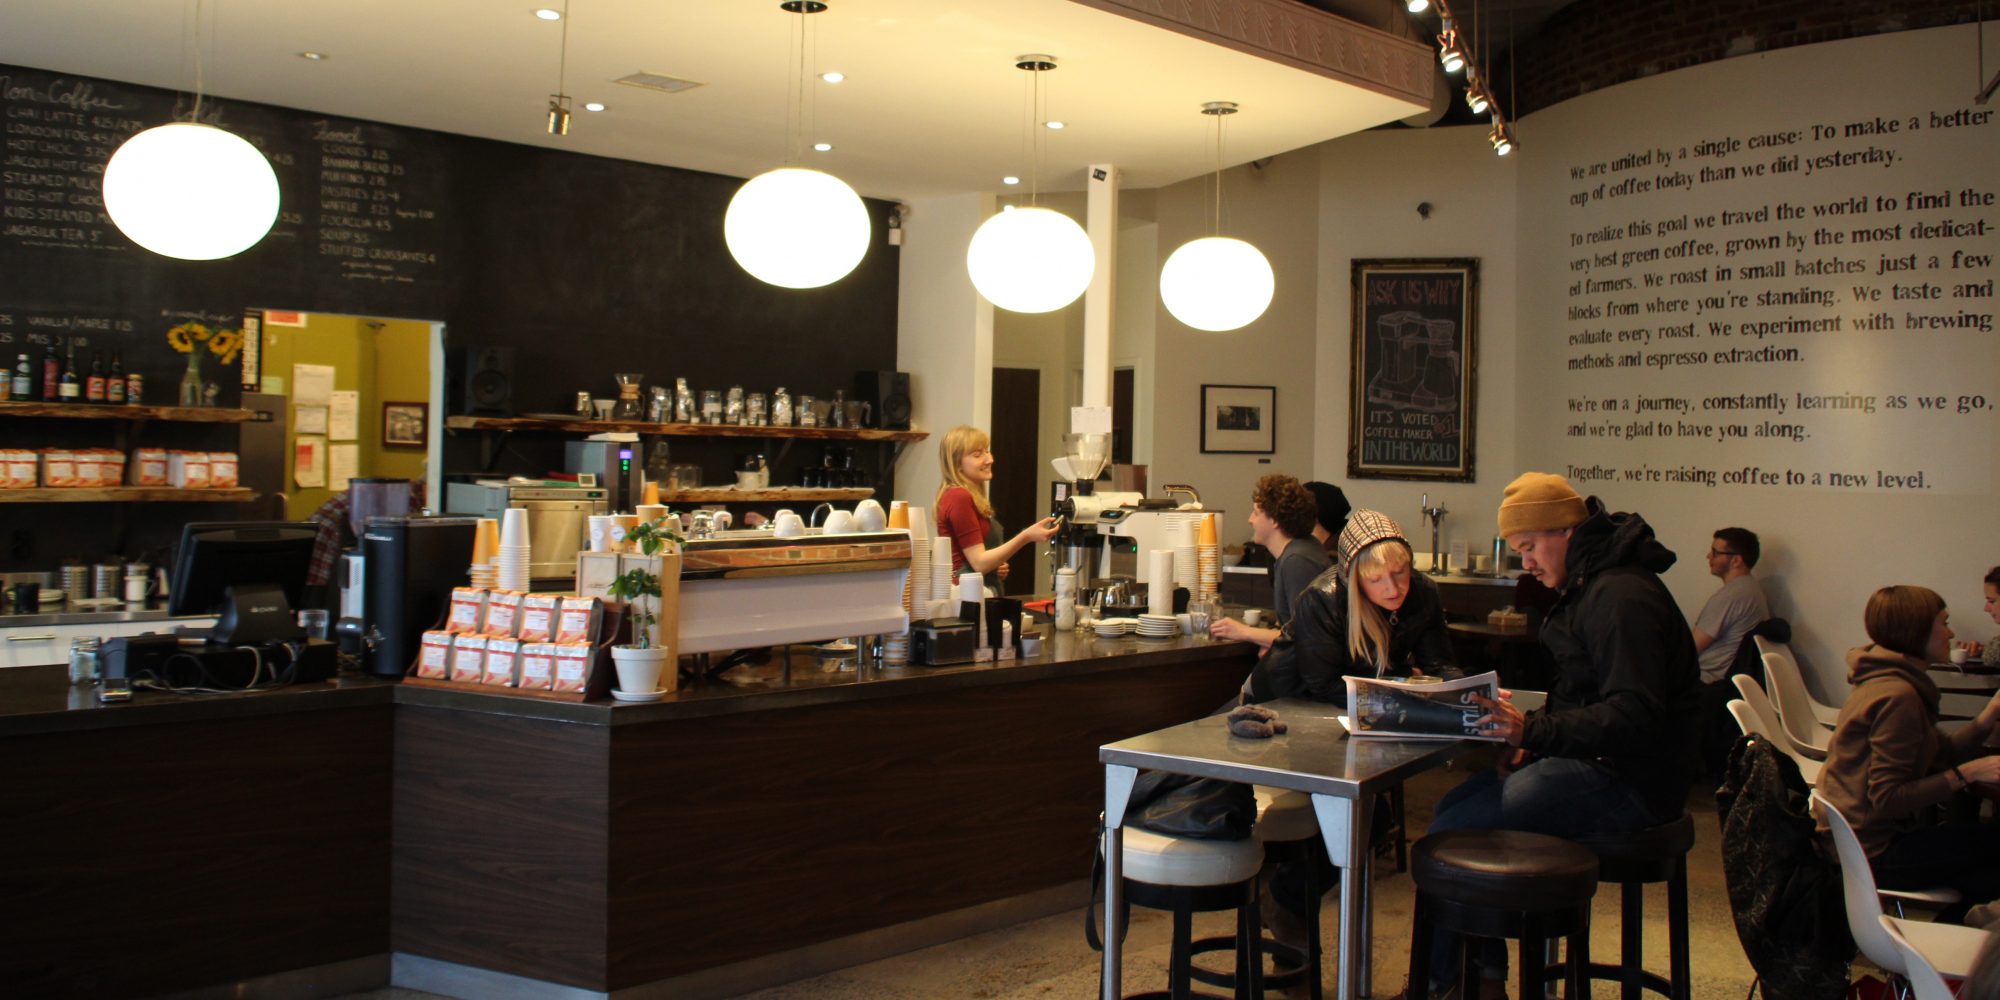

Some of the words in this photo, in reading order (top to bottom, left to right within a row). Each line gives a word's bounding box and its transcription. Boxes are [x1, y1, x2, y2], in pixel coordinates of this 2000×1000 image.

[7, 106, 41, 119] CHAI
[44, 110, 85, 125] LATTE
[6, 122, 62, 138] LONDON
[64, 130, 89, 142] FOG
[6, 139, 37, 151] HOT
[1571, 167, 1585, 180] We
[1589, 163, 1607, 176] are
[1611, 149, 1651, 172] united
[1657, 148, 1672, 168] by
[1679, 147, 1686, 159] a
[1694, 137, 1741, 158] single
[1748, 131, 1802, 150] cause:
[1811, 125, 1836, 141] To
[1844, 117, 1900, 138] make
[1908, 117, 1920, 130] a
[1930, 109, 1994, 128] better
[52, 160, 78, 171] HOT
[1570, 192, 1588, 207] cup
[1592, 184, 1605, 200] of
[1609, 178, 1651, 198] coffee
[1656, 171, 1694, 191] today
[1700, 166, 1735, 183] than
[1741, 164, 1765, 177] we
[1771, 155, 1799, 174] did
[1805, 146, 1902, 176] yesterday.
[3, 171, 65, 187] STEAMED
[68, 176, 99, 191] MILK
[3, 188, 35, 200] KIDS
[38, 192, 64, 203] HOT
[3, 206, 35, 219] KIDS
[37, 208, 93, 223] STEAMED
[1570, 233, 1583, 247] To
[1586, 225, 1623, 244] realize
[1628, 220, 1652, 238] this
[1657, 215, 1687, 237] goal
[1694, 216, 1715, 229] we
[1721, 205, 1768, 226] travel
[1776, 203, 1805, 221] the
[1813, 196, 1868, 217] world
[1876, 195, 1897, 212] to
[1906, 190, 1951, 211] find
[1959, 188, 1995, 207] the
[60, 228, 86, 241] TEA
[1570, 259, 1590, 274] very
[1594, 251, 1617, 267] best
[1622, 248, 1659, 268] green
[1664, 239, 1719, 259] coffee,
[1725, 236, 1780, 257] grown
[1786, 231, 1807, 253] by
[1814, 228, 1844, 245] the
[1851, 224, 1902, 243] most
[1910, 219, 1995, 239] dedicat-
[1569, 280, 1581, 296] ed
[1586, 278, 1636, 294] farmers.
[1644, 272, 1663, 287] We
[1670, 267, 1708, 285] roast
[1716, 265, 1732, 282] in
[1740, 261, 1785, 280] small
[1795, 257, 1866, 276] batches
[1876, 253, 1917, 276] just
[1928, 256, 1939, 269] a
[1952, 250, 1993, 269] few
[1368, 280, 1397, 305] ASK
[1401, 280, 1421, 305] US
[1424, 280, 1460, 305] WHY
[1568, 304, 1601, 320] blocks
[1607, 301, 1639, 317] from
[1646, 297, 1689, 313] where
[1696, 290, 1748, 315] you're
[1757, 287, 1840, 307] standing.
[1853, 286, 1881, 301] We
[1892, 282, 1942, 300] taste
[1953, 279, 1993, 298] and
[1569, 329, 1612, 346] evaluate
[1618, 328, 1650, 345] every
[1659, 322, 1700, 339] roast.
[1708, 321, 1732, 336] We
[1740, 315, 1842, 339] experiment
[1852, 313, 1895, 330] with
[1906, 310, 1993, 332] brewing
[1568, 353, 1614, 370] methods
[1618, 351, 1641, 367] and
[1646, 351, 1708, 370] espresso
[1713, 345, 1804, 364] extraction.
[1568, 395, 1597, 412] We're
[1602, 399, 1617, 411] on
[1622, 399, 1629, 410] a
[1635, 394, 1695, 415] journey,
[1703, 393, 1788, 415] constantly
[1797, 392, 1876, 413] learning
[1886, 395, 1907, 408] as
[1917, 396, 1947, 409] we
[1957, 395, 1993, 414] go,
[1370, 411, 1393, 426] IT'S
[1401, 413, 1439, 426] VOTED
[1365, 428, 1399, 440] COFFEE
[1402, 428, 1433, 441] MAKER
[1568, 422, 1586, 437] and
[1590, 420, 1621, 437] we're
[1625, 421, 1653, 440] glad
[1658, 422, 1672, 437] to
[1678, 420, 1713, 437] have
[1718, 424, 1748, 443] you
[1754, 421, 1810, 442] along.
[1567, 465, 1620, 483] Together,
[1625, 464, 1661, 482] we're
[1665, 466, 1717, 487] raising
[1722, 467, 1780, 485] coffee
[1786, 469, 1805, 485] to
[1811, 473, 1821, 485] a
[1829, 473, 1868, 487] new
[1877, 470, 1931, 488] level.
